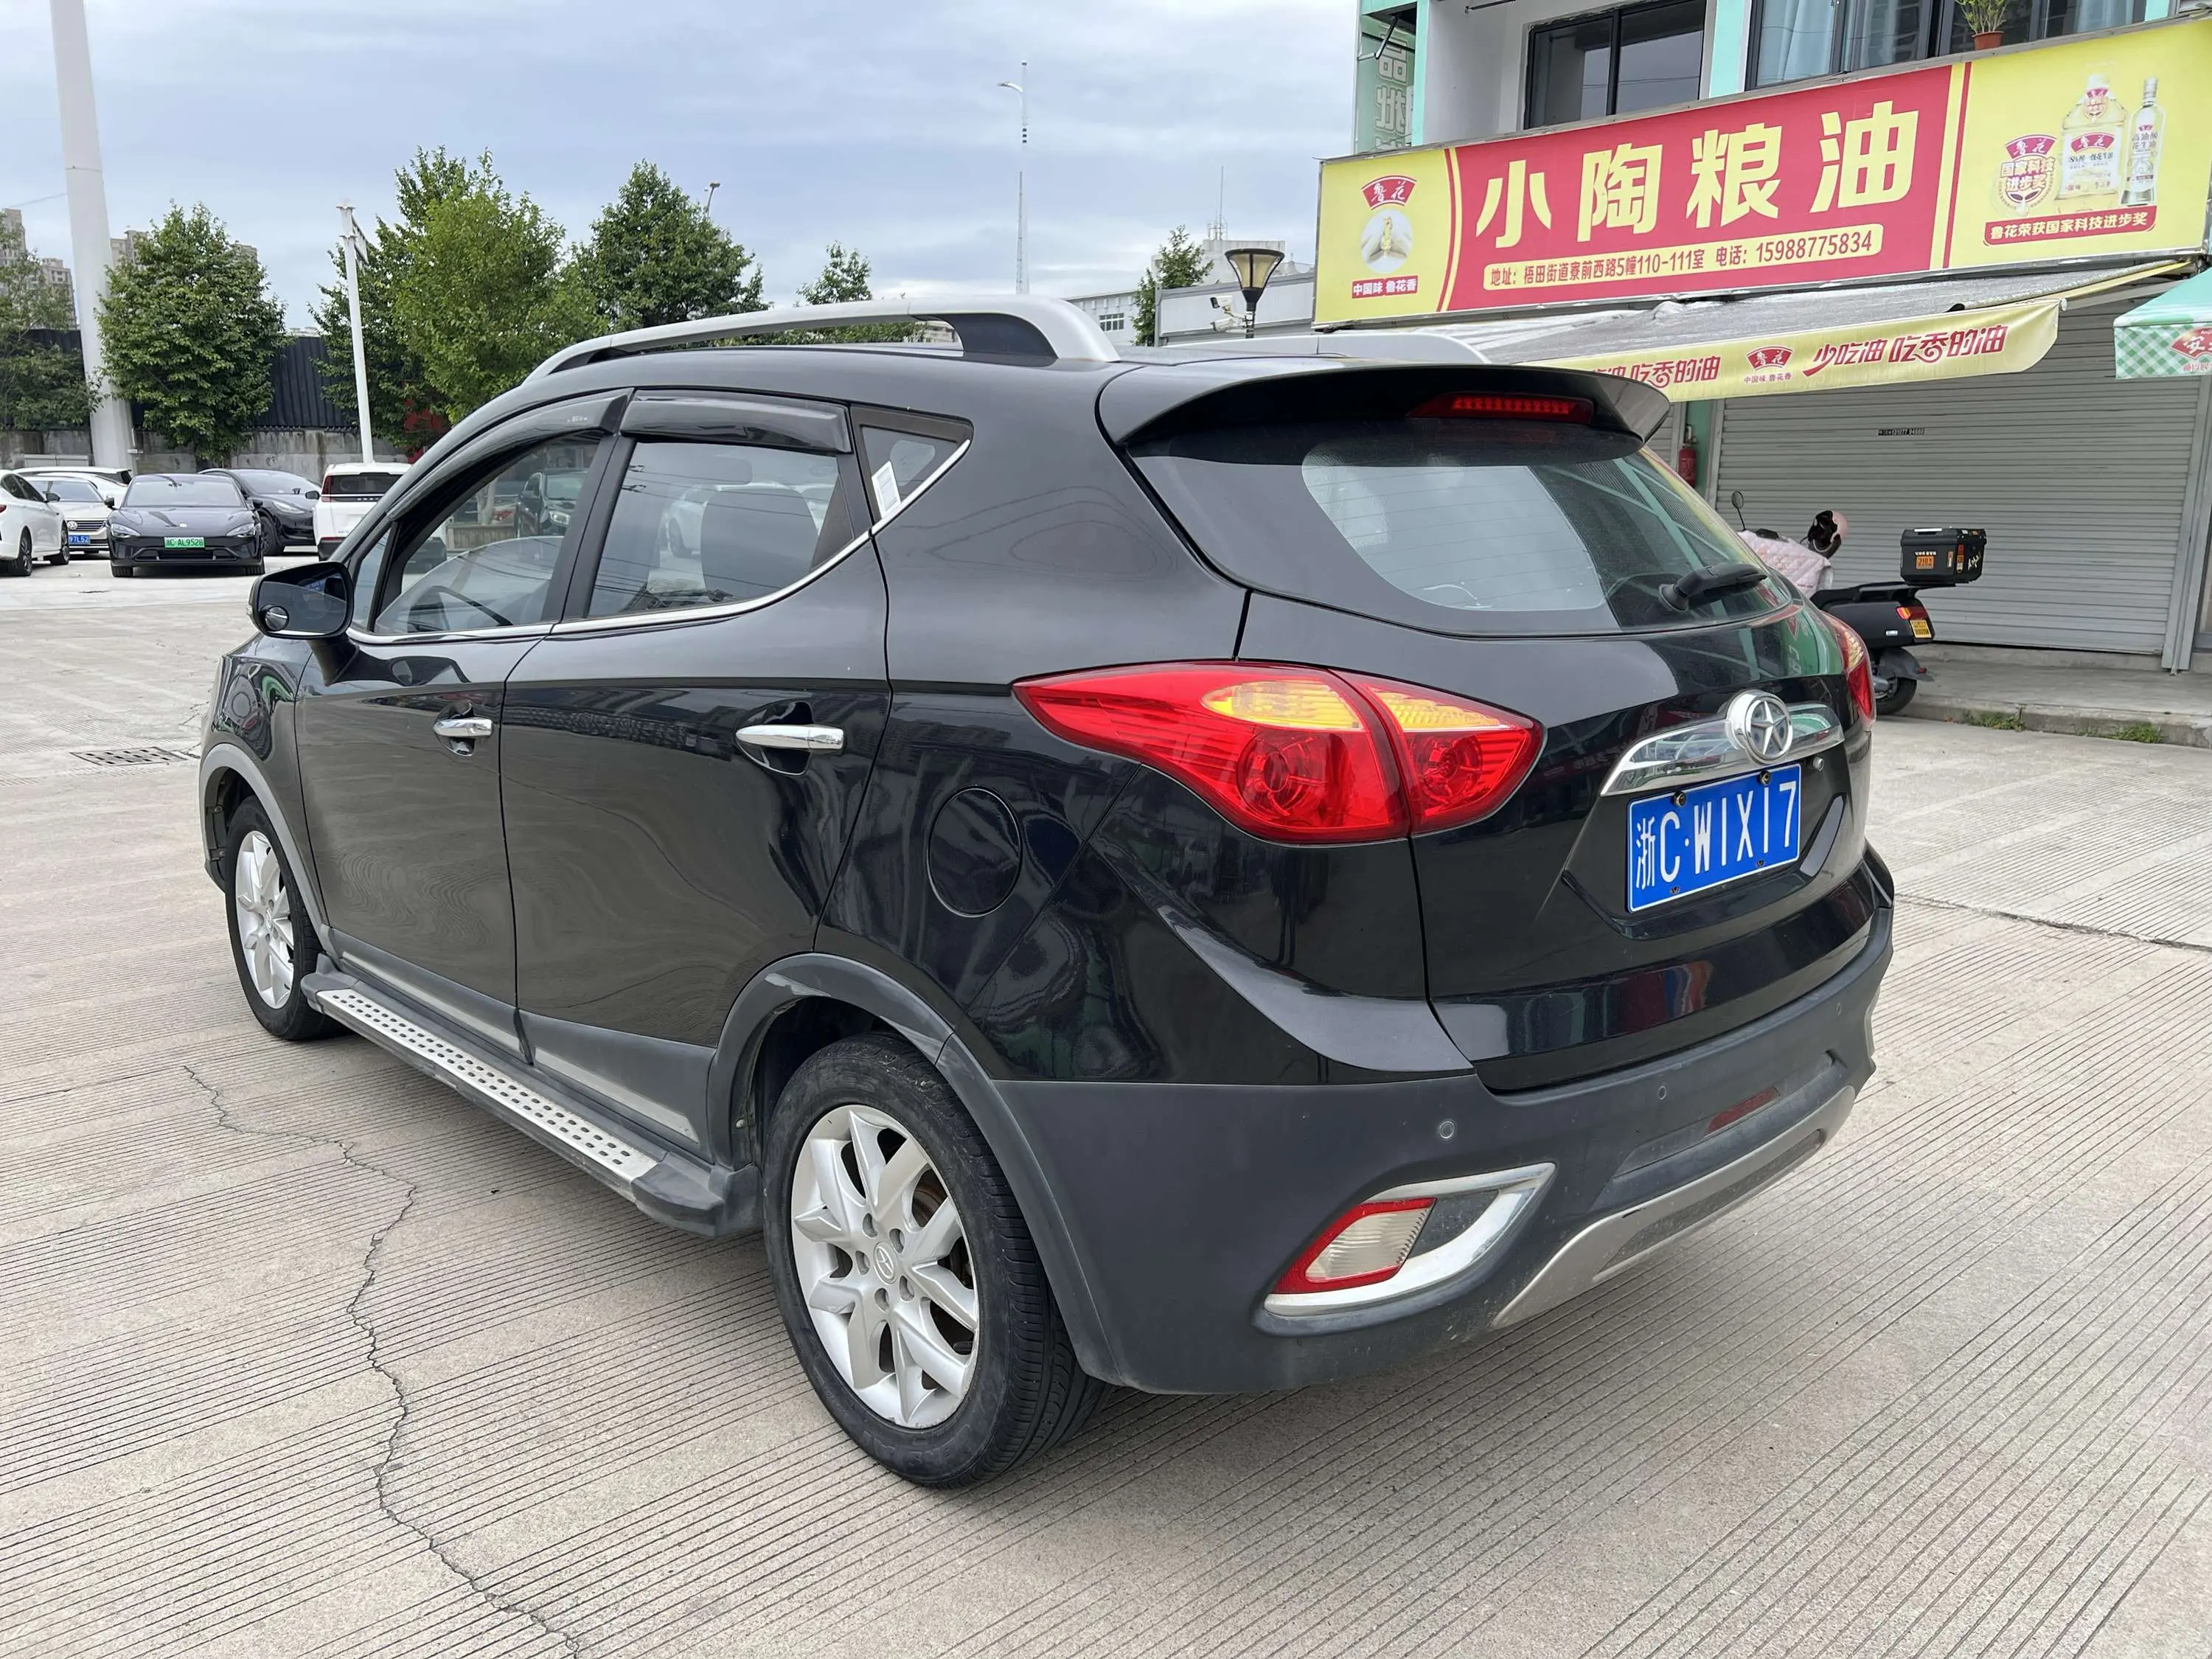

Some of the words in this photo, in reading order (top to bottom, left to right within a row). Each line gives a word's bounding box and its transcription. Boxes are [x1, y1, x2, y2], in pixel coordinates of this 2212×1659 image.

[2013, 137, 2048, 156] 鲁花
[1475, 100, 1919, 248] 小陶粮油
[1371, 181, 1406, 203] 鲁花
[1990, 212, 2148, 240] 鲁花荣获国家科技进步奖
[1802, 338, 1888, 377] 少吃油
[1888, 324, 2008, 364] 吃香的油
